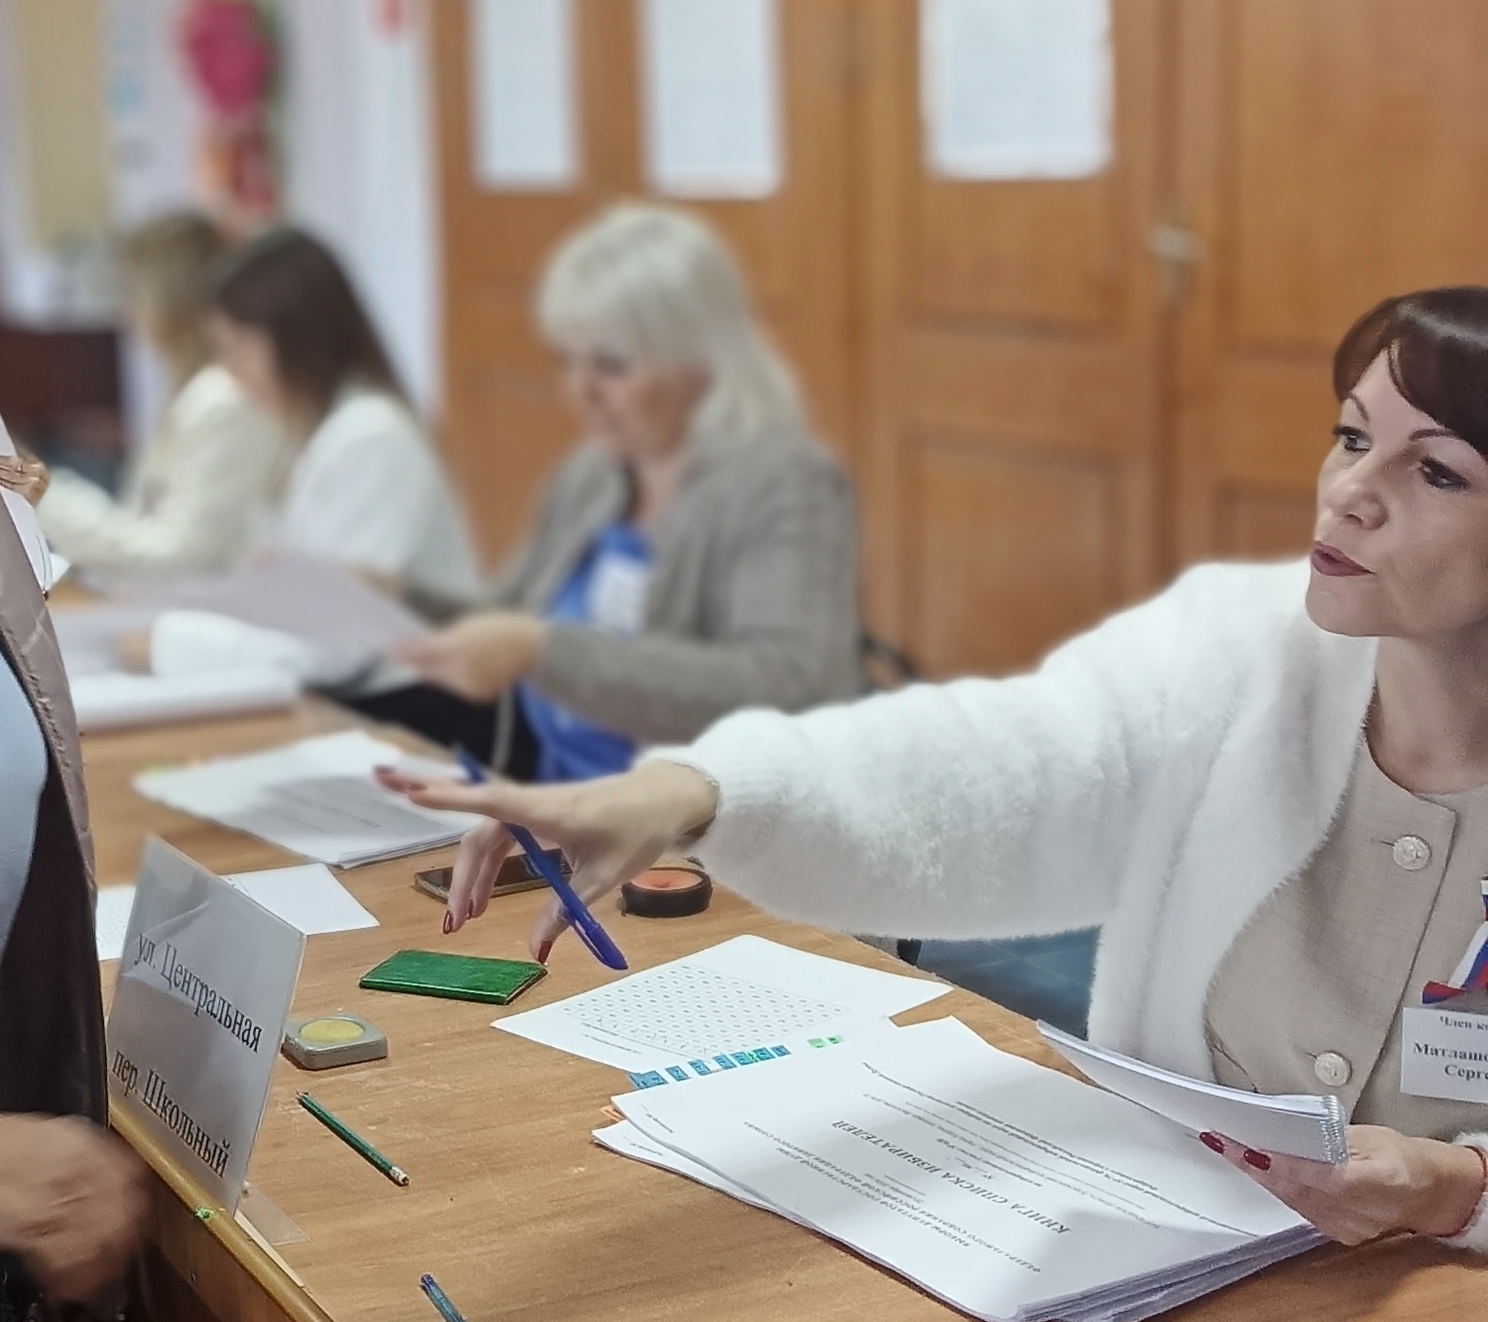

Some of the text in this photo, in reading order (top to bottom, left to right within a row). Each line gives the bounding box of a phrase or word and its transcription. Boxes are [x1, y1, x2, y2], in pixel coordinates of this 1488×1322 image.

[134, 933, 263, 1054] ул. Центральная
[1440, 1016, 1472, 1029] Член
[112, 1048, 232, 1179] пер. Школьный
[830, 1120, 941, 1173] ИЗБИРАТЕЛЕЙ
[939, 1172, 1007, 1204] СПИСКА
[1008, 1202, 1070, 1233] КНИГА
